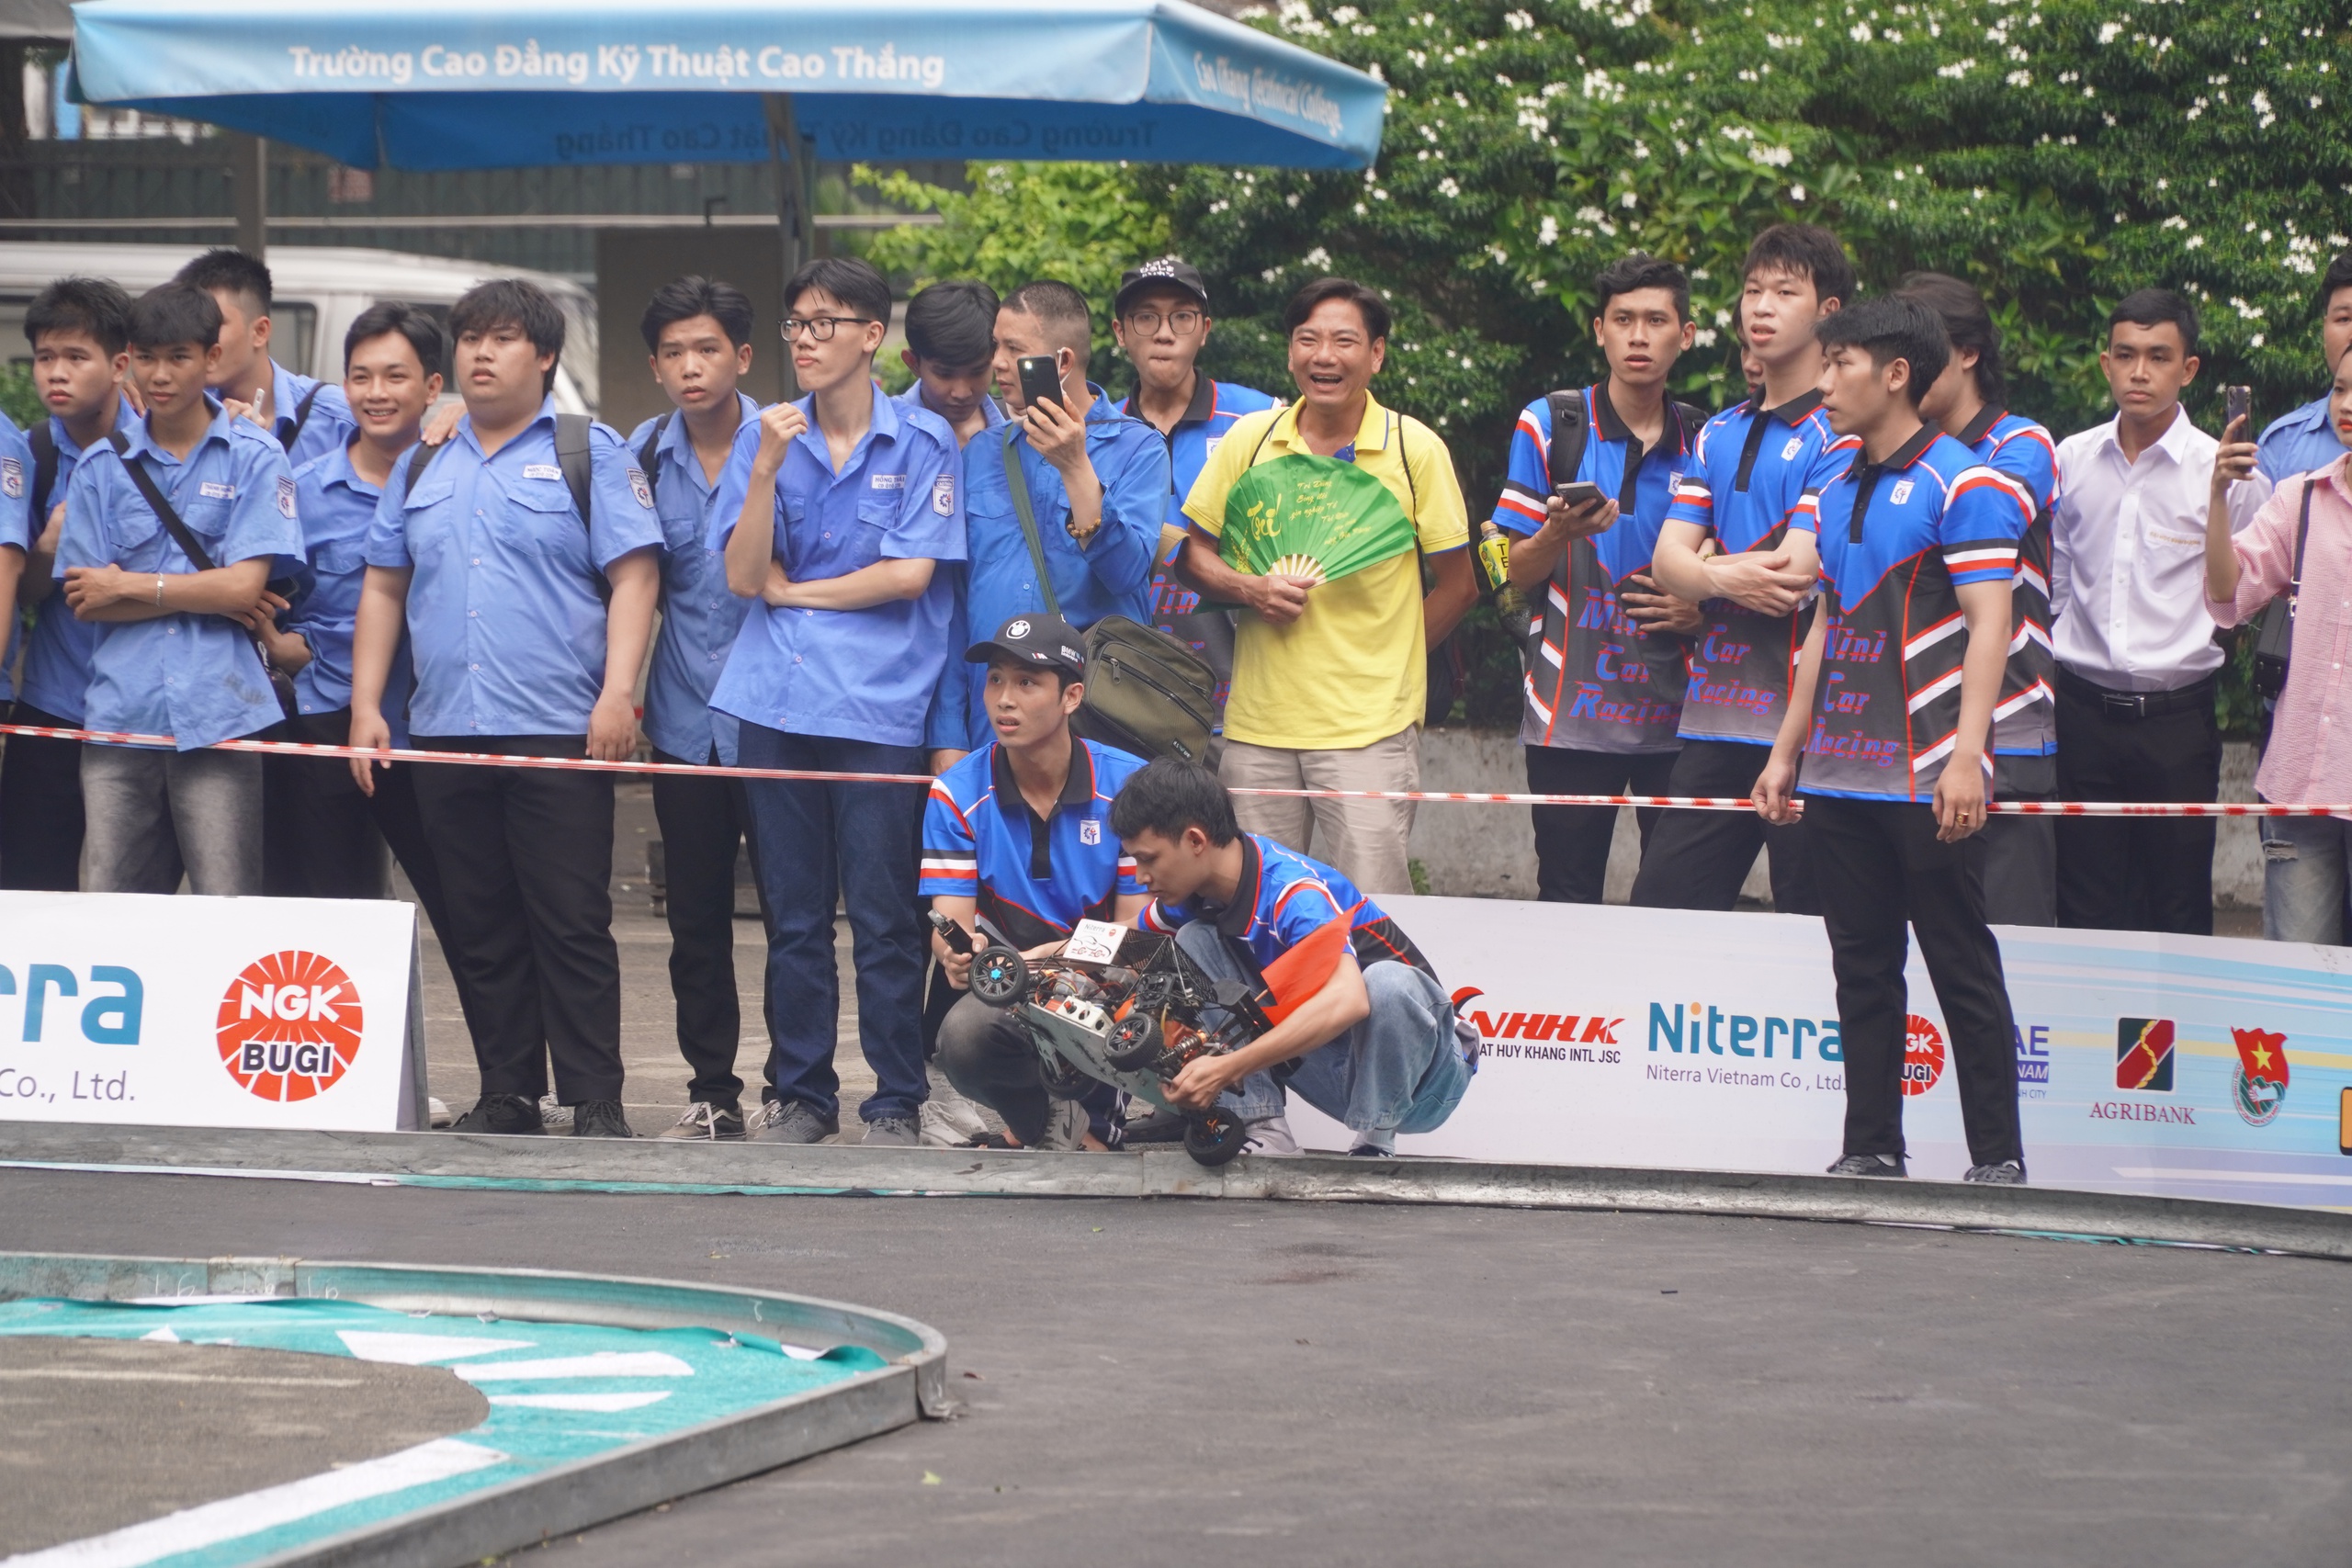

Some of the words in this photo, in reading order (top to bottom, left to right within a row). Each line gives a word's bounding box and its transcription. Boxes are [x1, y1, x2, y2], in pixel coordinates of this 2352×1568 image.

[288, 44, 413, 85] Trường
[421, 44, 488, 77] Cao
[494, 38, 589, 85] Đẳng
[597, 43, 640, 85] Kỹ
[646, 43, 751, 86] Thuật
[757, 46, 826, 78] Cao
[831, 42, 945, 89] Thắng
[1702, 624, 1751, 664] Car
[1684, 665, 1777, 716] Racing
[240, 983, 343, 1024] NGK
[1648, 1001, 1845, 1063] Niterra
[1905, 1032, 1935, 1055] GK
[2014, 1024, 2050, 1057] AE
[242, 1043, 334, 1075] BUGI
[1479, 1043, 1495, 1057] AT
[1497, 1043, 1521, 1059] HUY
[1525, 1045, 1566, 1061] KHANG
[1569, 1048, 1595, 1063] INTL
[1598, 1049, 1621, 1065] JSC
[72, 1069, 136, 1102] Ltd.
[1646, 1064, 1702, 1083] Niterra
[1707, 1067, 1775, 1088] Vietnam
[1816, 1074, 1847, 1091] Ltd.
[1903, 1065, 1931, 1081] UGI
[2017, 1064, 2049, 1080] NAM
[2029, 1089, 2047, 1100] CITY
[2088, 1101, 2197, 1125] AGRIBANK
